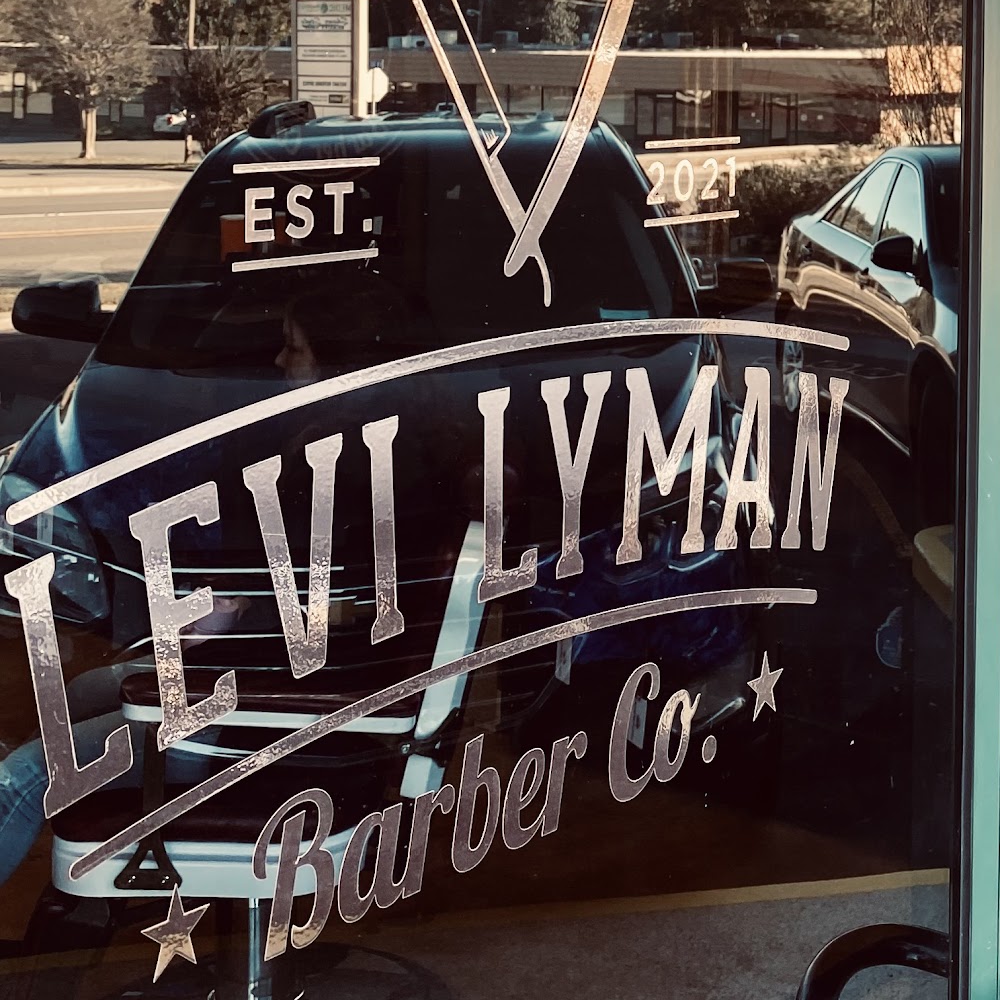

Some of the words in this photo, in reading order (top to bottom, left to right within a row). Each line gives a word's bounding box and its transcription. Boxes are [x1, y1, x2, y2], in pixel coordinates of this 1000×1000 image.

[245, 182, 373, 243] EST.
[648, 157, 736, 205] 2021
[5, 416, 405, 820] LEVI
[477, 366, 850, 603] LYMAN
[252, 730, 587, 962] Barber
[608, 663, 717, 802] Co.
